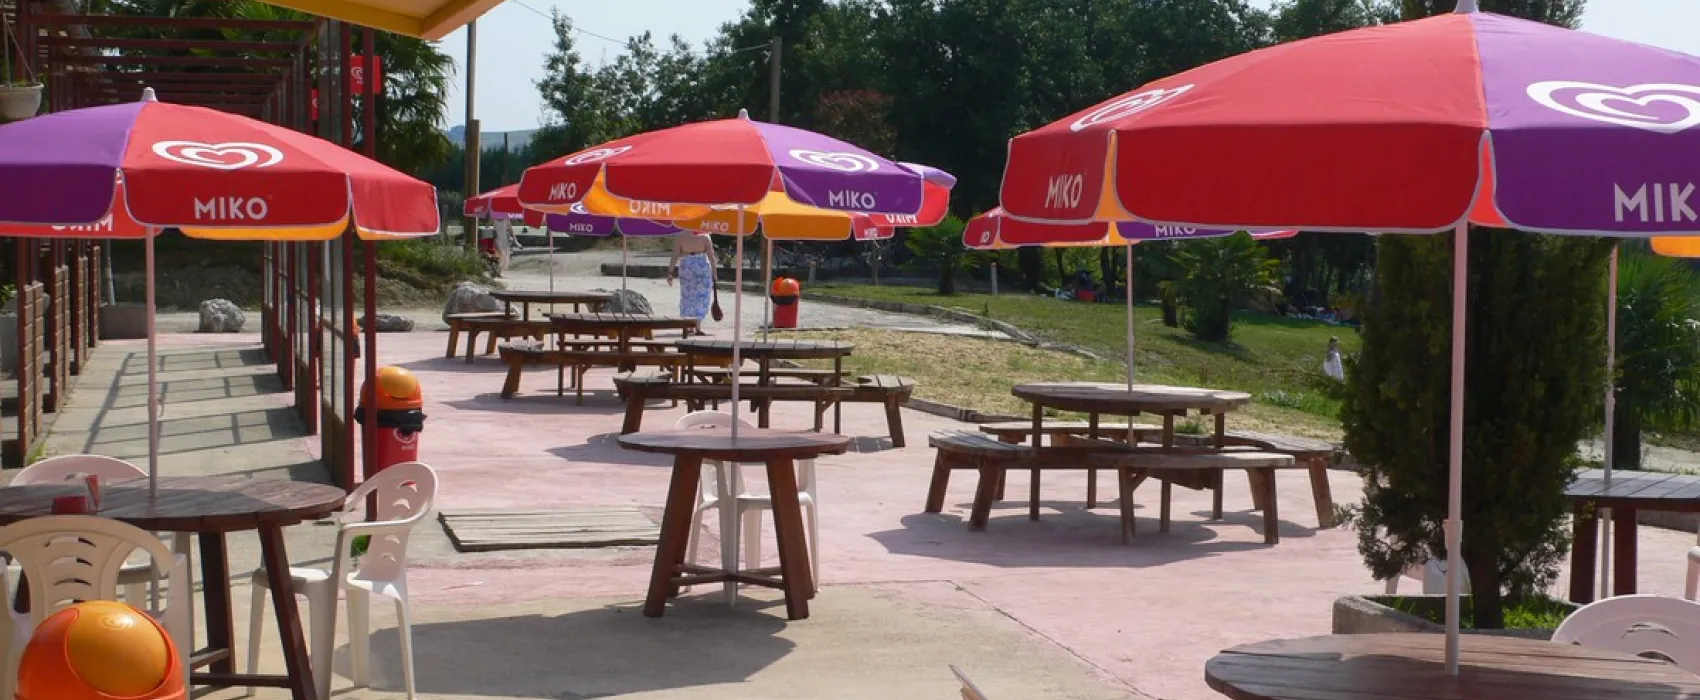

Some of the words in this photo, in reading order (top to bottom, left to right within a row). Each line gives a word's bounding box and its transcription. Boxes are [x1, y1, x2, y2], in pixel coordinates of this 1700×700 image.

[549, 182, 577, 200] MIKO
[828, 189, 876, 209] MIKO
[1044, 174, 1082, 209] MIKO
[194, 196, 268, 220] MIKO
